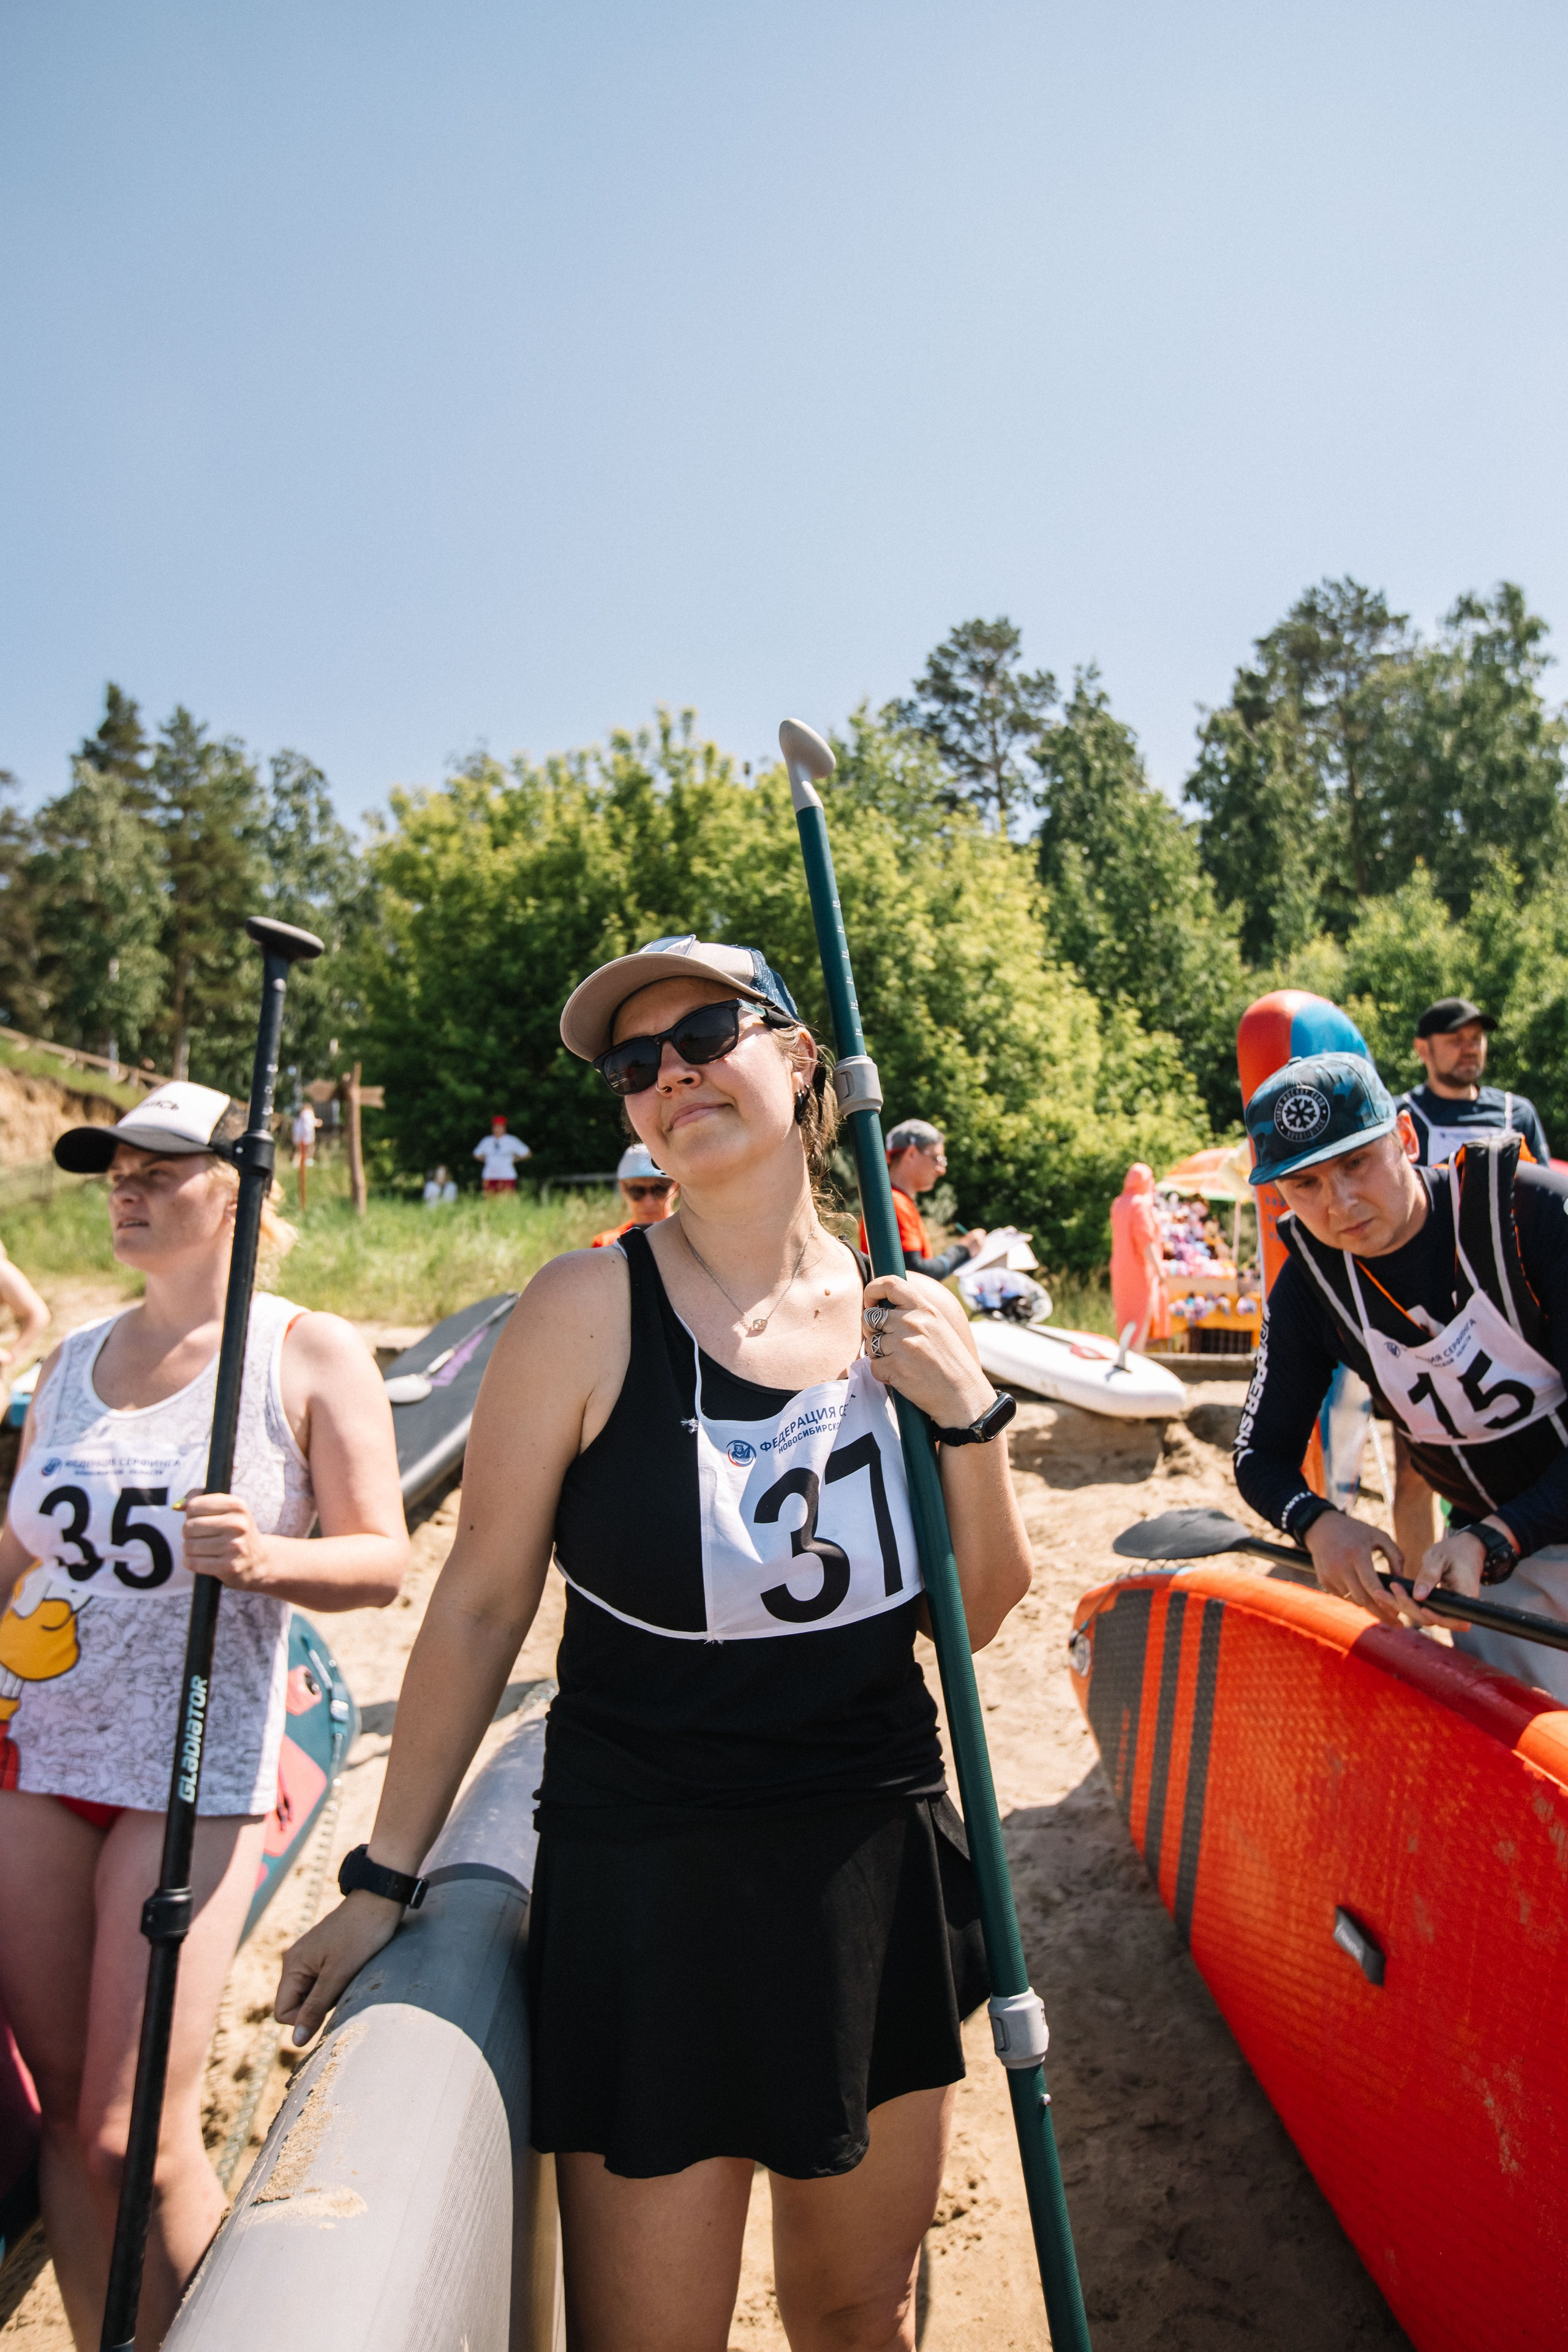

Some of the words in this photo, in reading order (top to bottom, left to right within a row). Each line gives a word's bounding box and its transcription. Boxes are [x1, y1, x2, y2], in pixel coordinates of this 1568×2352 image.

[1282, 1089, 1309, 1102] HOCKEY
[1311, 1092, 1326, 1107] CLUB
[1407, 1349, 1536, 1440] 15
[760, 1406, 835, 1452] ФЕДЕРАЦИЯ
[778, 1422, 840, 1454] НОВОСИБИРСКО
[39, 1485, 173, 1589] 35
[754, 1432, 903, 1623] 37
